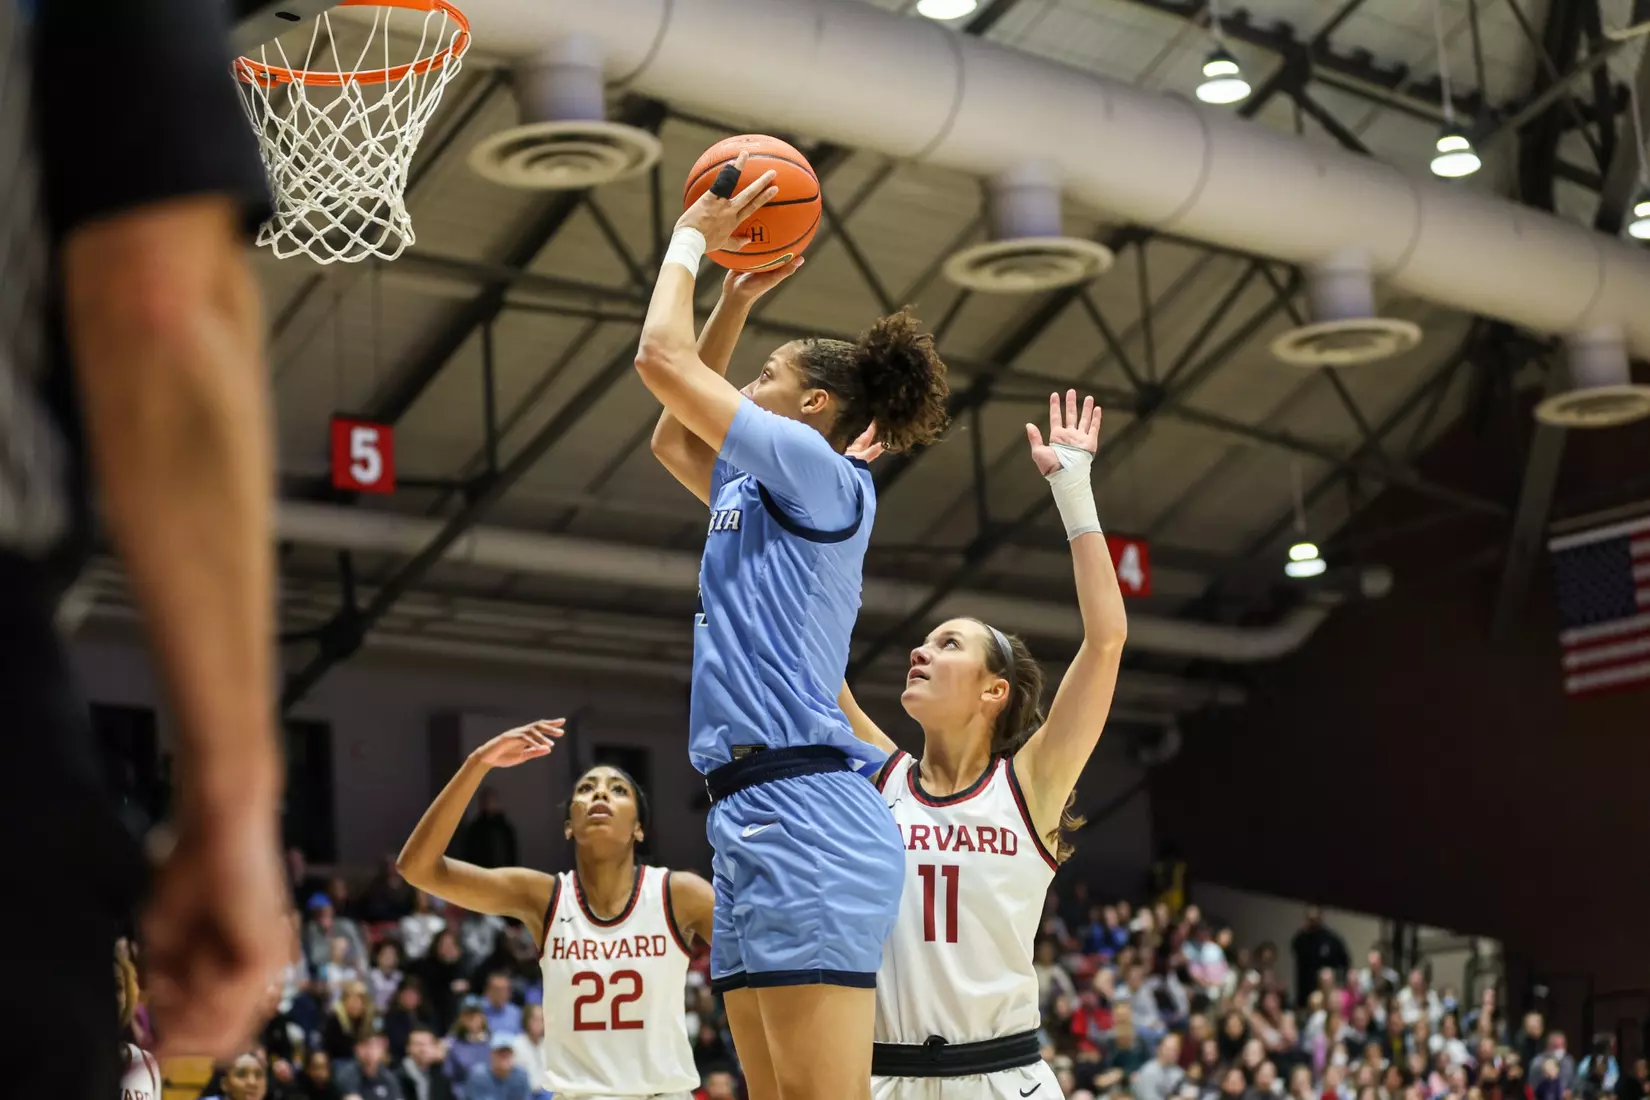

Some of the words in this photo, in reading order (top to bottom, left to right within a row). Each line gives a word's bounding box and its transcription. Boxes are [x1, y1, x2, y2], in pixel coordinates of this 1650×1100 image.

[751, 227, 763, 242] H
[350, 427, 383, 484] 5
[1118, 544, 1145, 592] 4
[918, 864, 960, 943] 11
[552, 935, 667, 960] HARVARD
[572, 970, 644, 1031] 22
